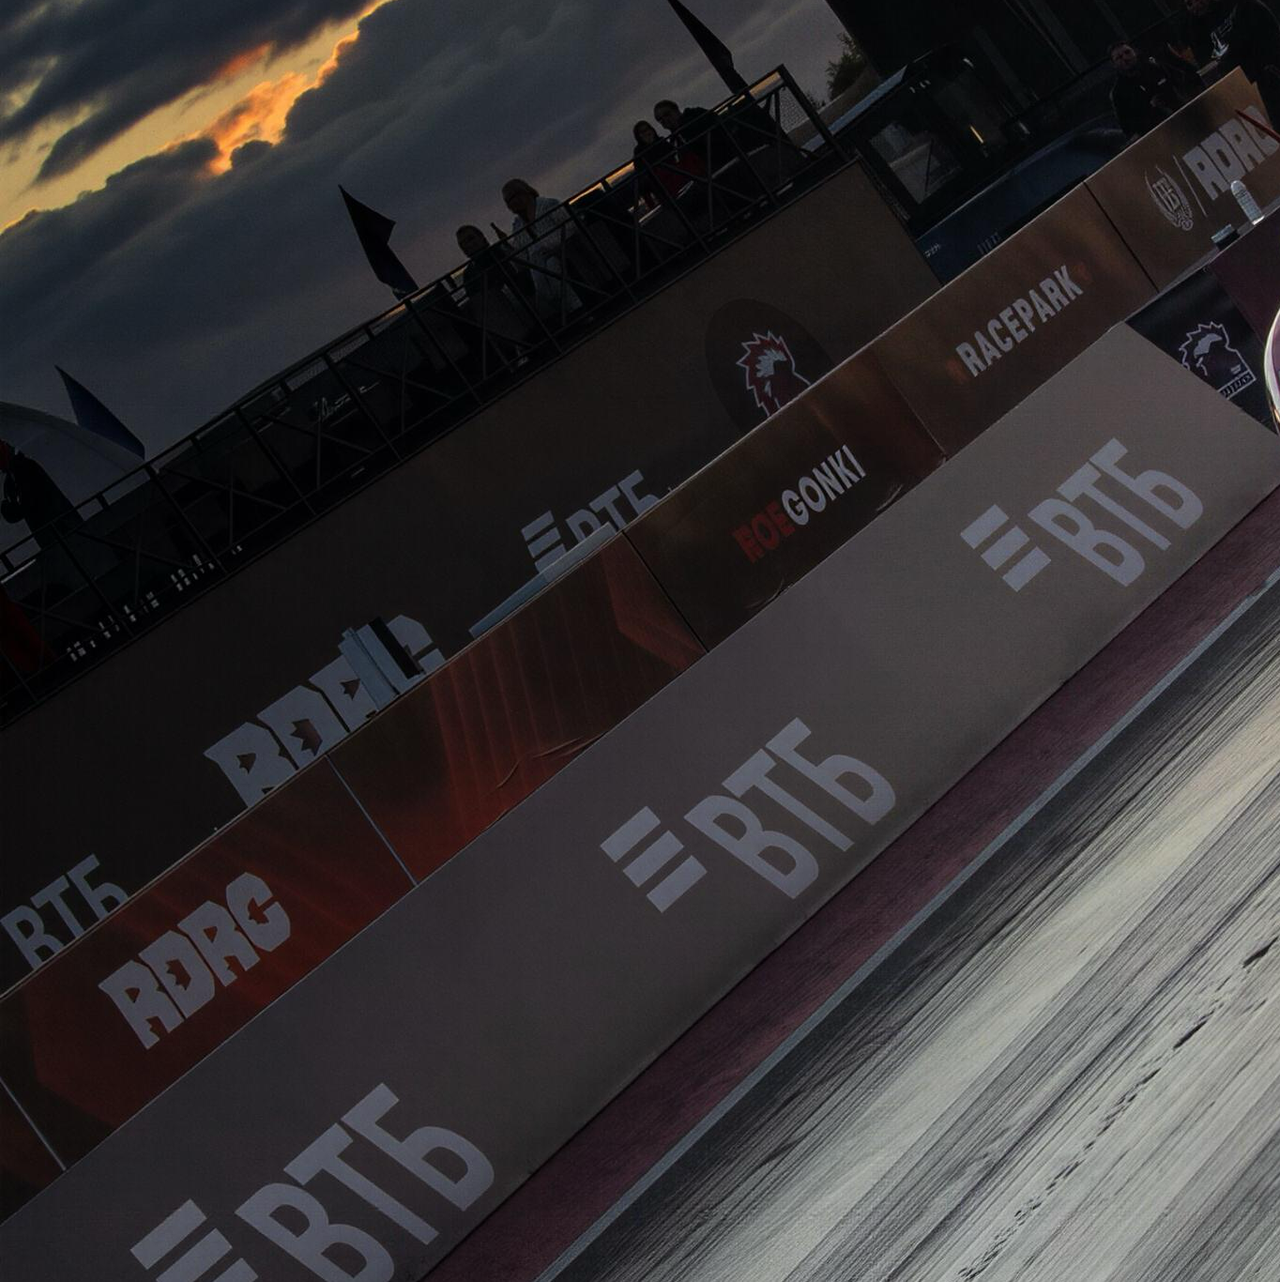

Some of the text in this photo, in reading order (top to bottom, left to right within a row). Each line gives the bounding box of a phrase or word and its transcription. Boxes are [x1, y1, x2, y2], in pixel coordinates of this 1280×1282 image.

[955, 264, 1084, 378] RACEPARK
[1028, 436, 1205, 587] ВТБ
[685, 717, 897, 899] ВТБ
[97, 871, 292, 1051] RDRC
